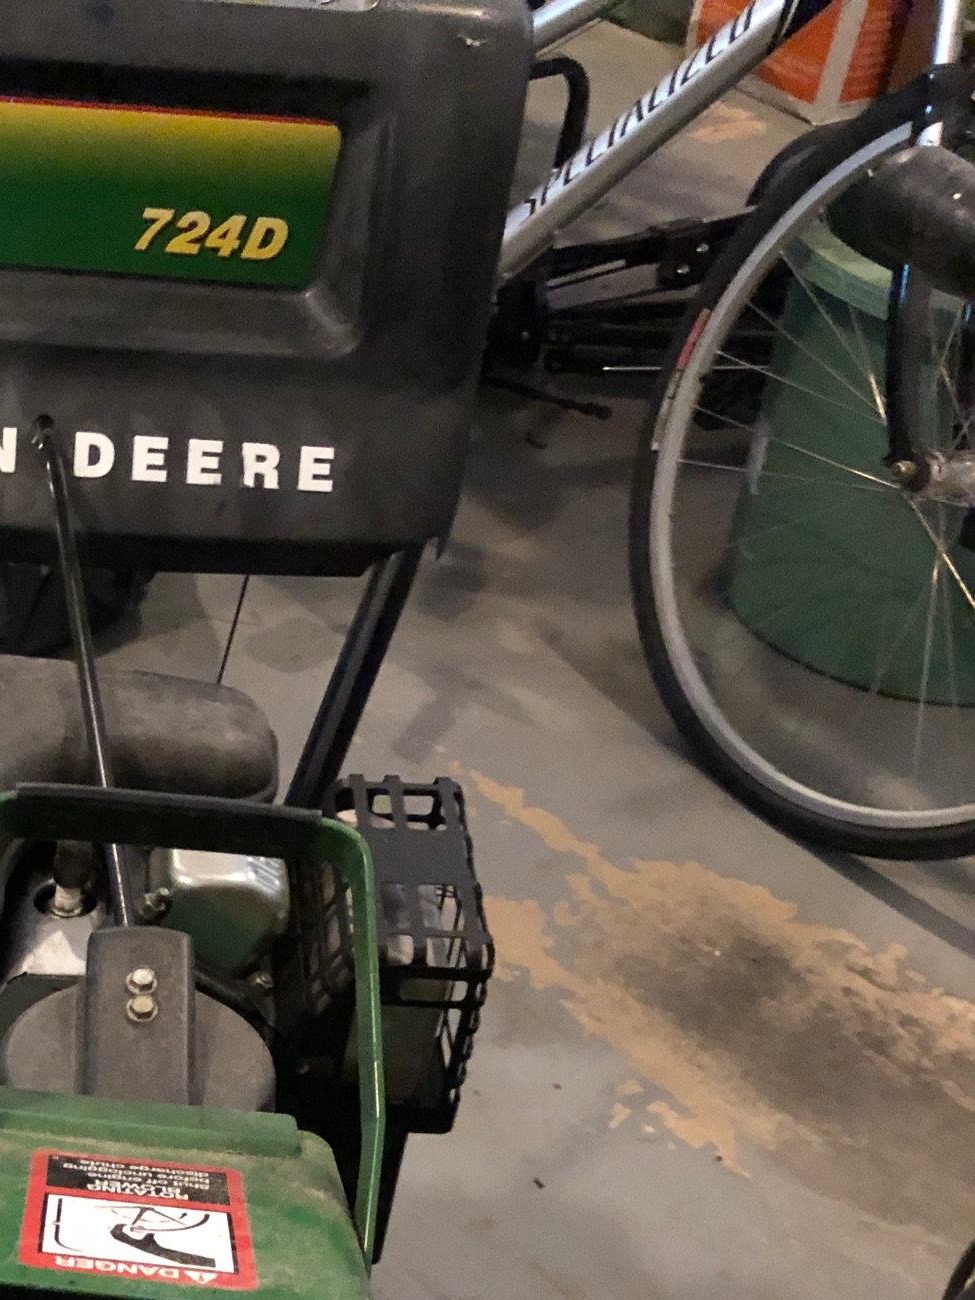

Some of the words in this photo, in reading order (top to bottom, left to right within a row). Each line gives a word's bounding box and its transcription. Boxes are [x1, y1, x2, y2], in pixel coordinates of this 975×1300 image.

[133, 207, 289, 262] 724D
[72, 431, 337, 493] DEERE
[87, 1183, 189, 1200] ROTATING
[94, 1179, 181, 1194] BLOWER
[146, 1177, 168, 1186] off
[55, 1255, 180, 1280] DANGER
